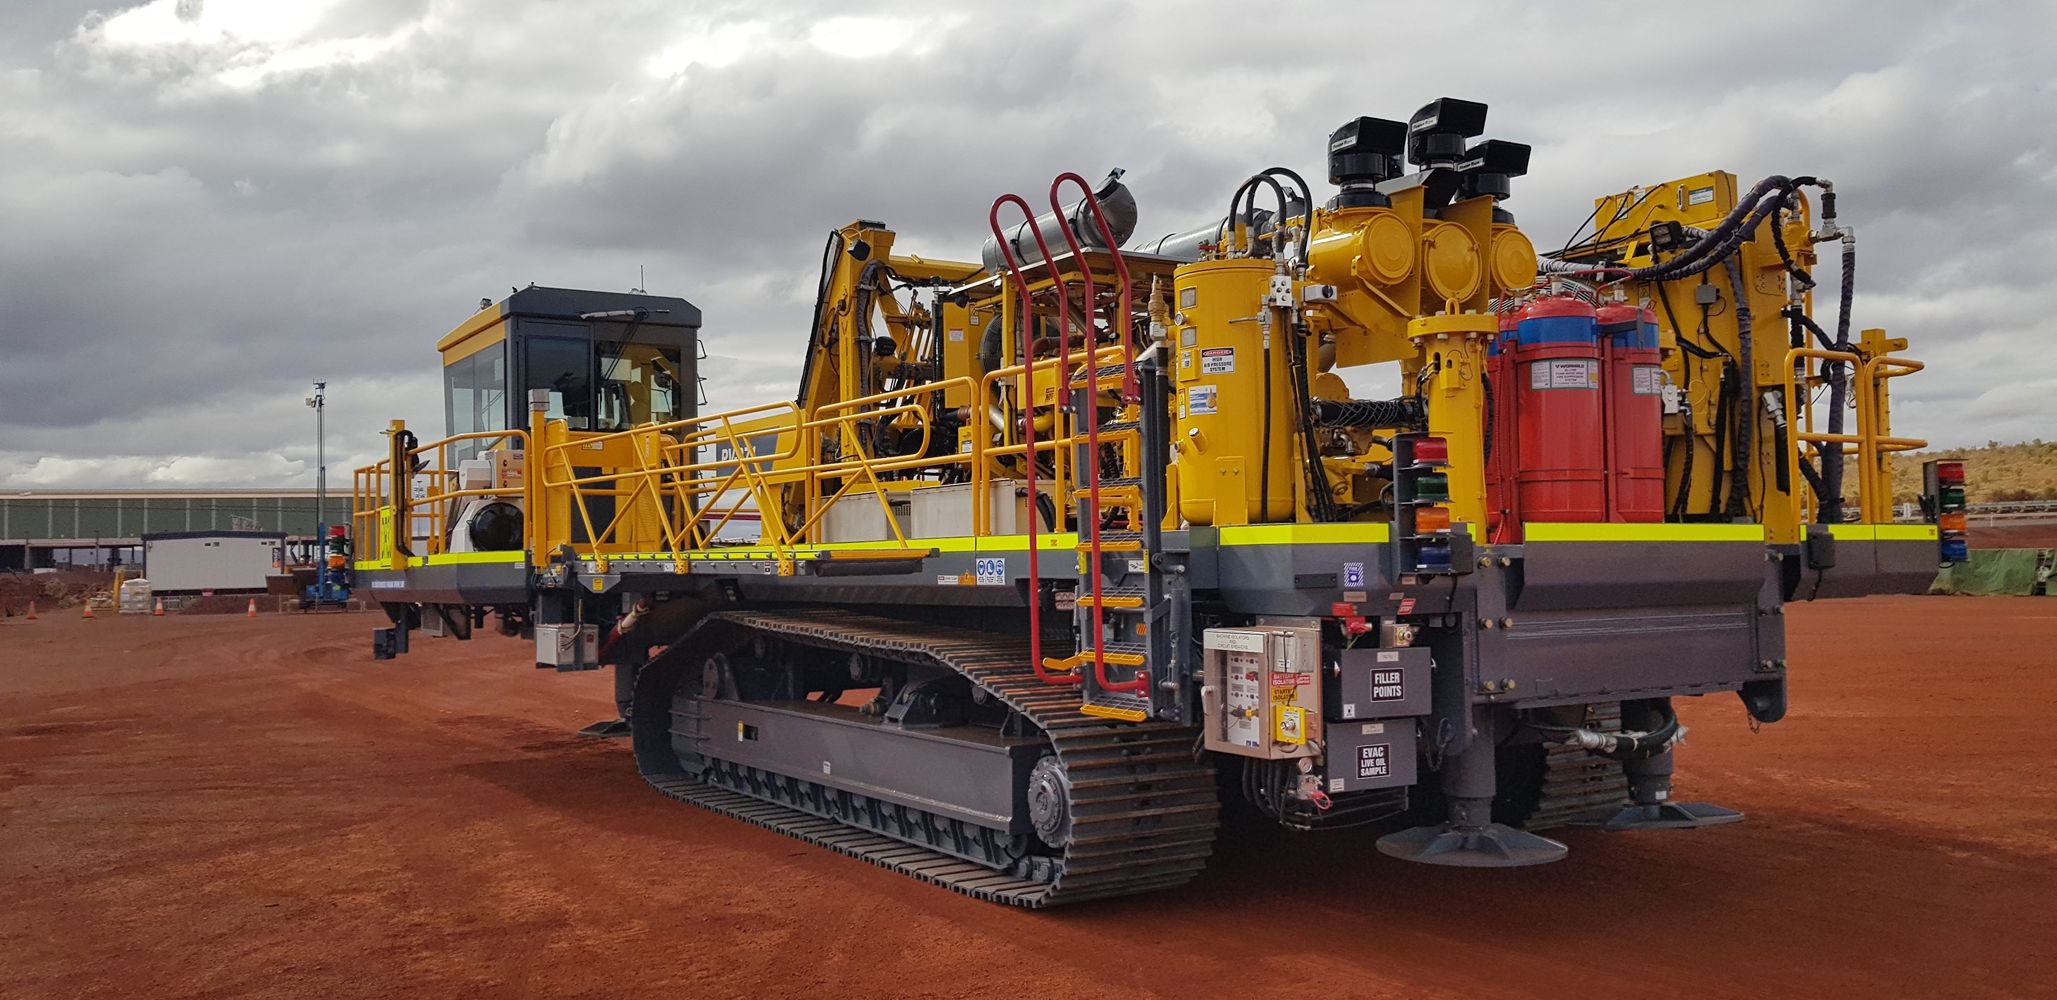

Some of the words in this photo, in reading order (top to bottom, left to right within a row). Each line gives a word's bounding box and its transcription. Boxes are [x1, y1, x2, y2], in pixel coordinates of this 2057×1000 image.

[1375, 672, 1400, 684] FILLER
[1373, 685, 1402, 698] POINTS
[1363, 747, 1384, 758] EVAC
[1361, 759, 1375, 767] LIVE
[1375, 758, 1386, 766] OIL
[1361, 767, 1387, 776] SAMPLE
